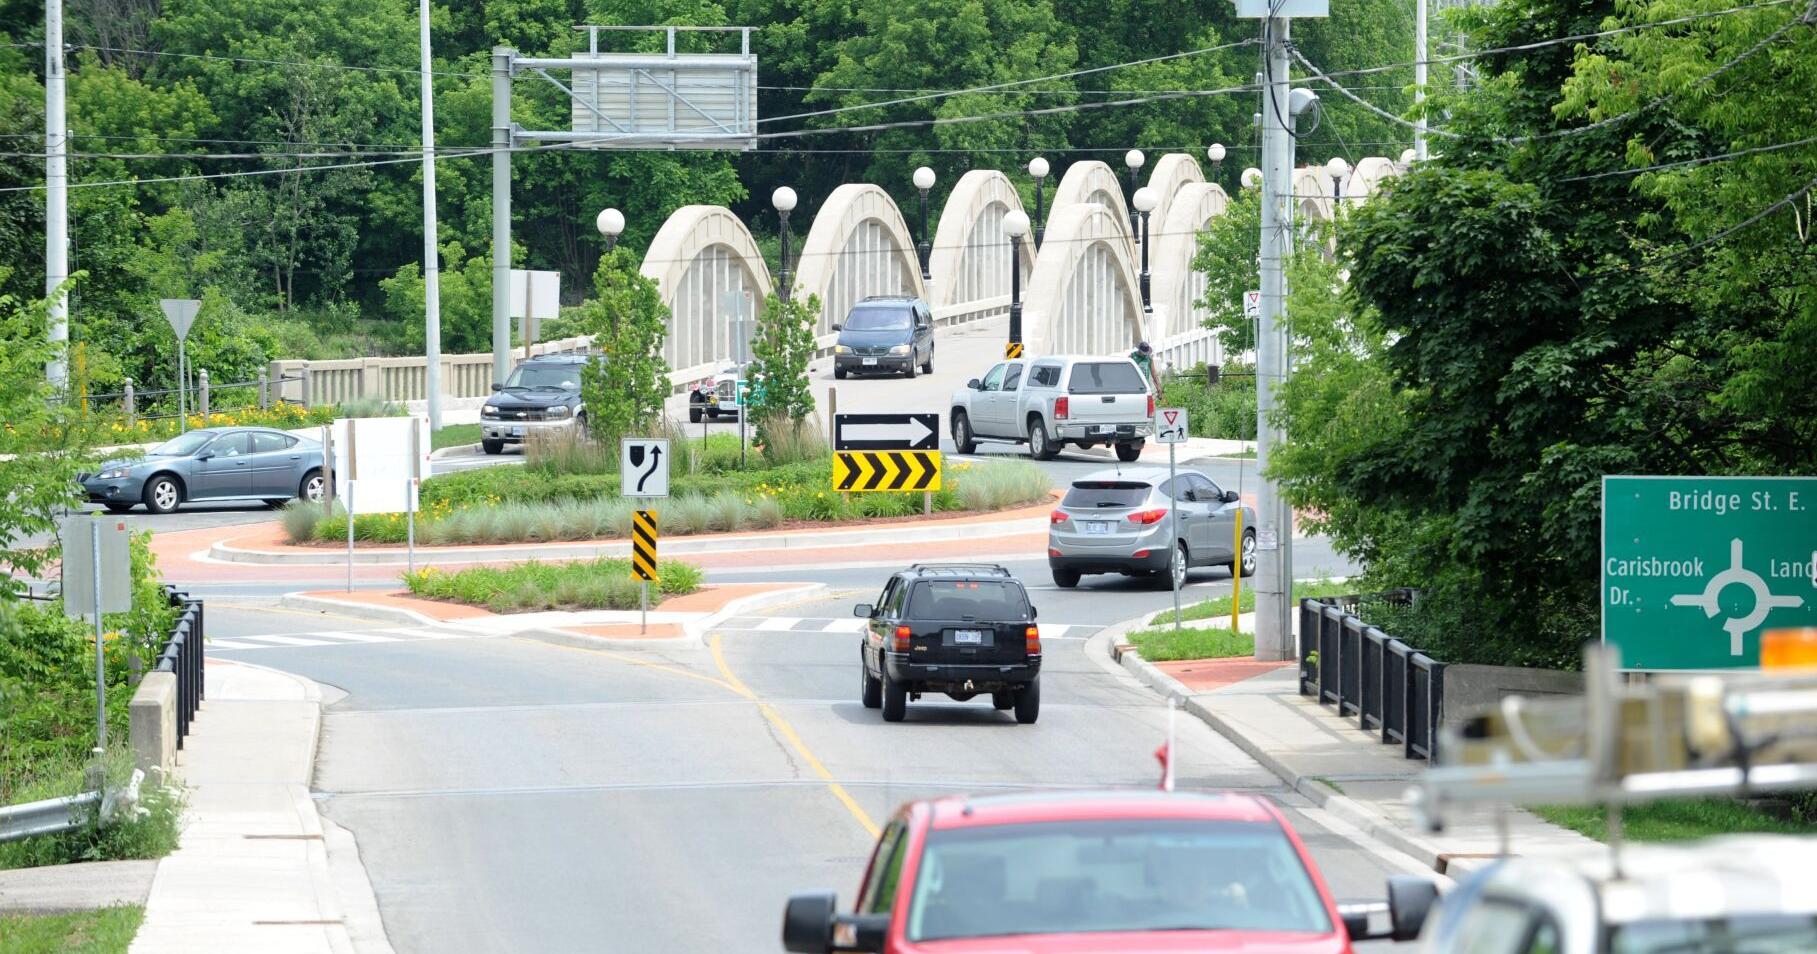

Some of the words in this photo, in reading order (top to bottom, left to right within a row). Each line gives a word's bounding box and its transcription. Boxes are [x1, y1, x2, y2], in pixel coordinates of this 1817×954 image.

[1669, 489, 1741, 515] Bridge
[1751, 491, 1778, 510] St.
[1789, 491, 1806, 511] E.
[1606, 556, 1704, 577] Carisbrook
[1610, 586, 1633, 605] Dr.
